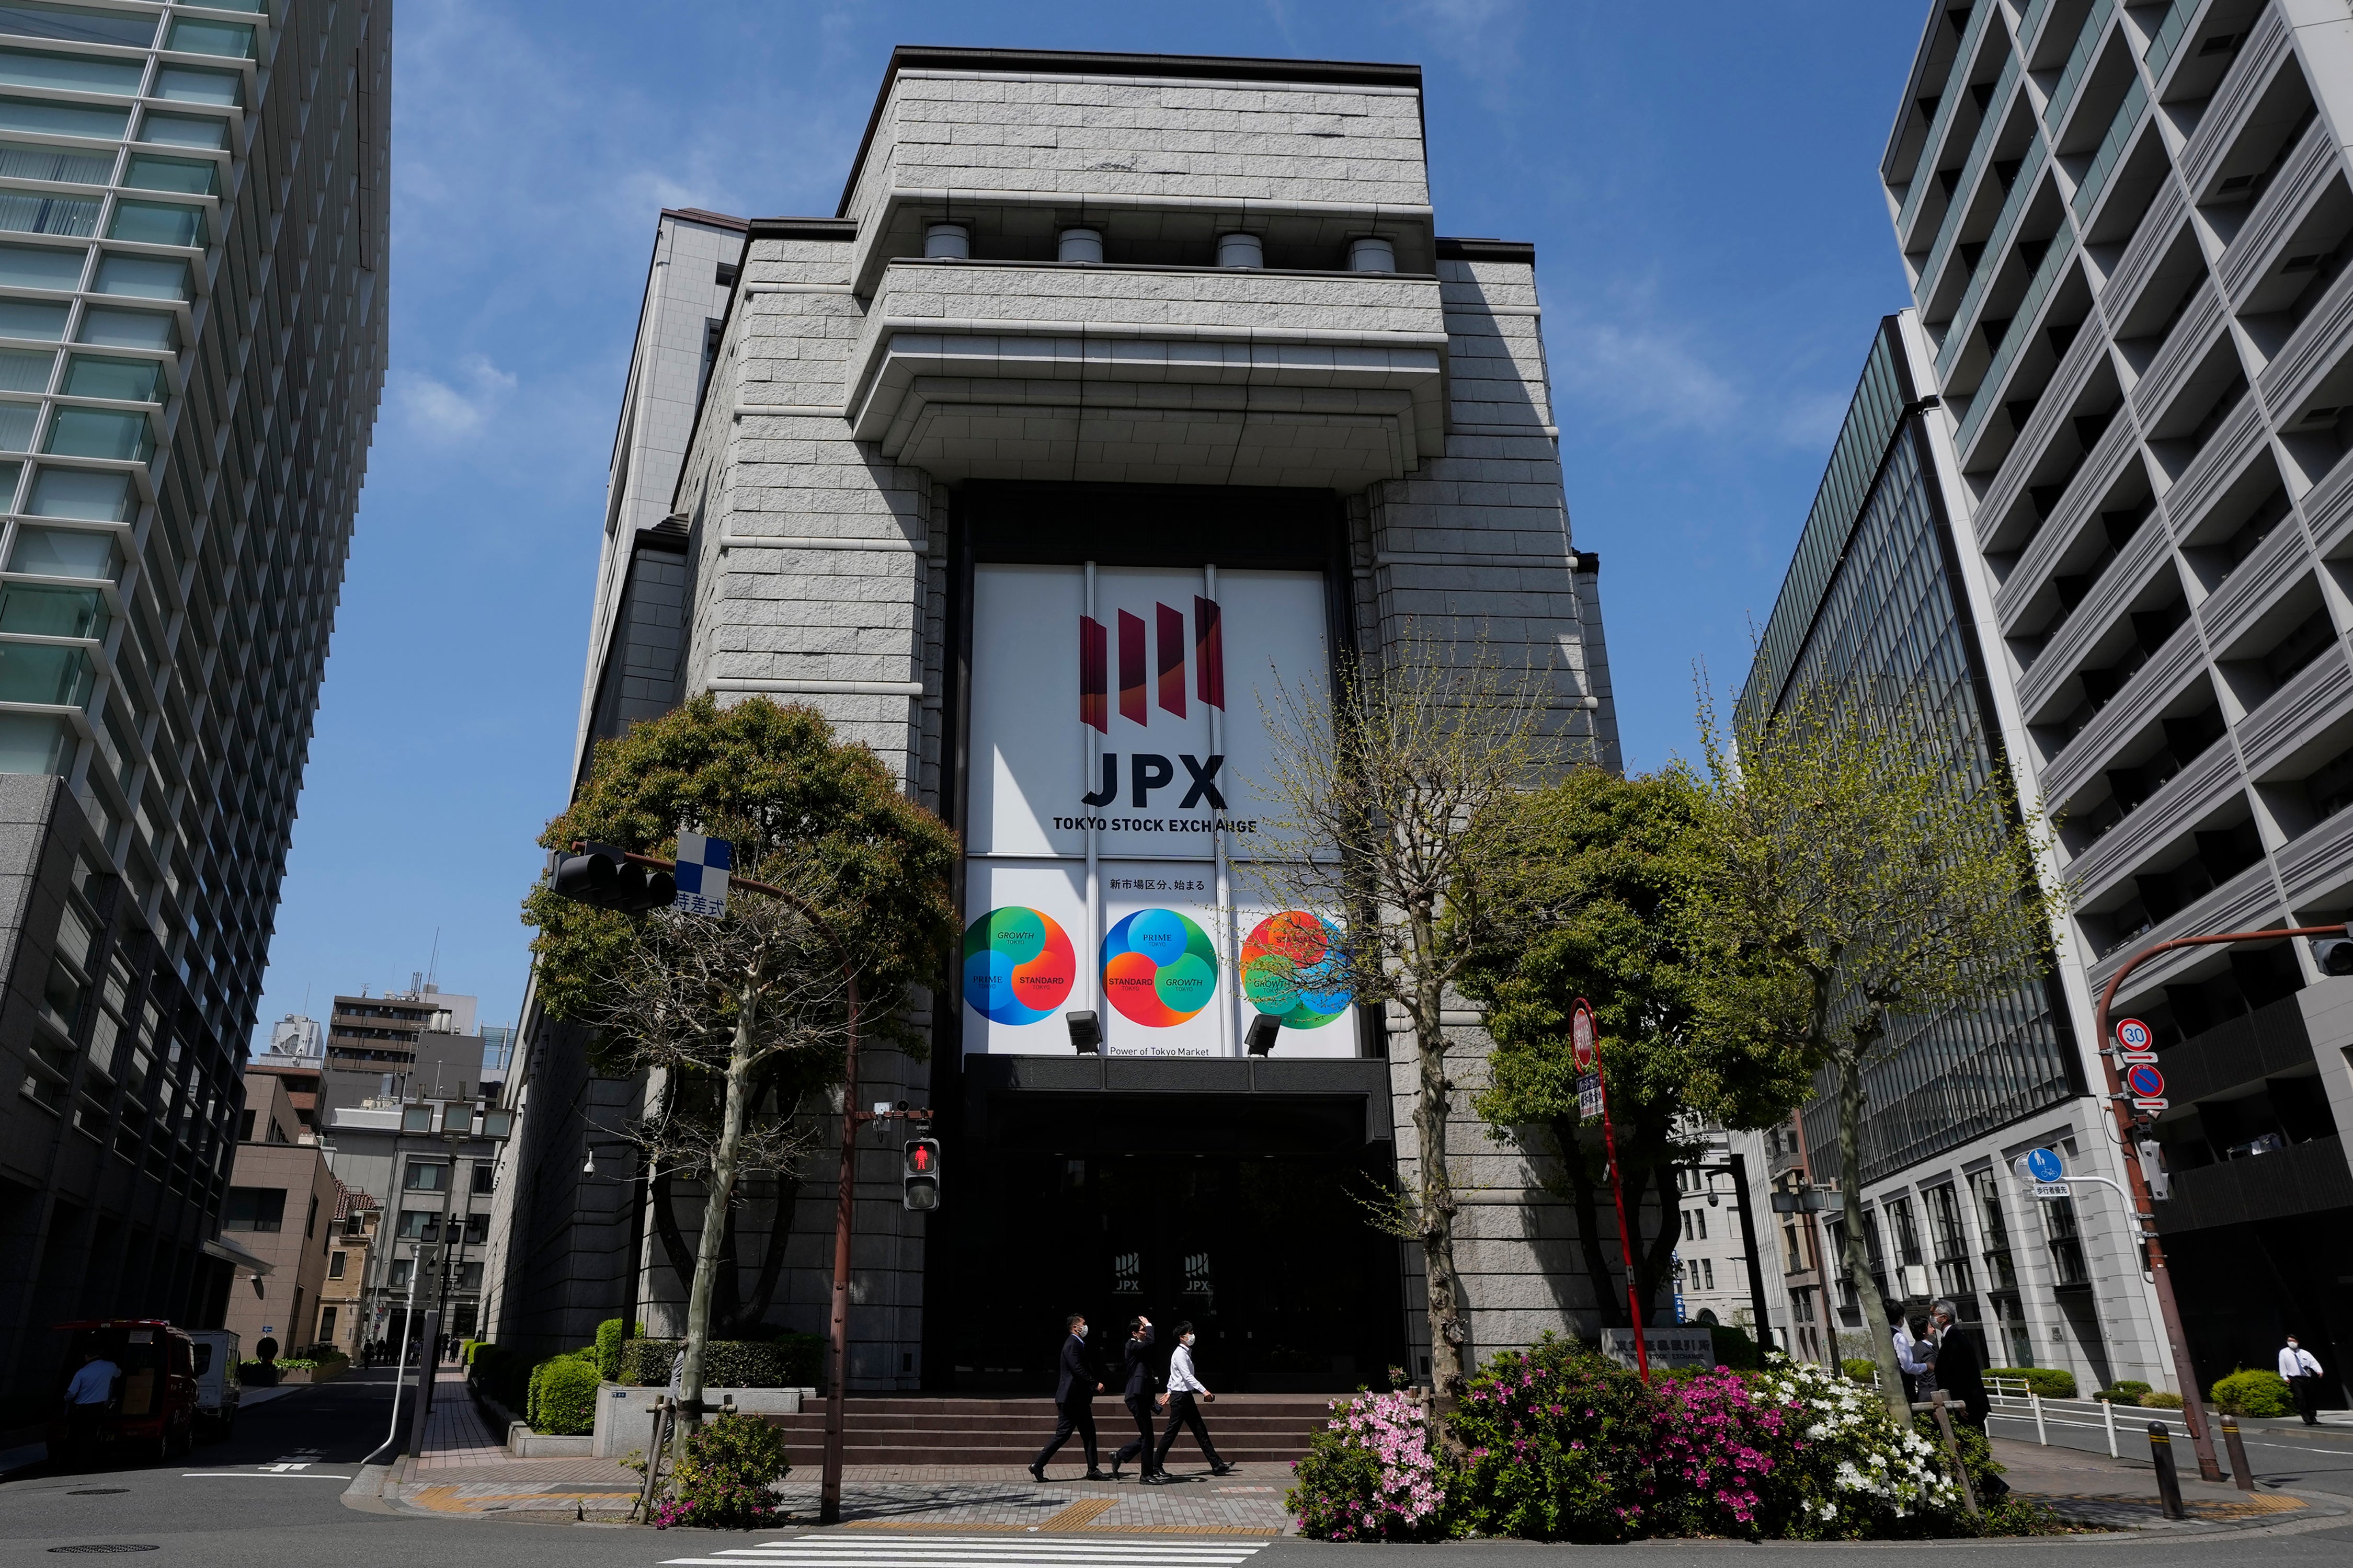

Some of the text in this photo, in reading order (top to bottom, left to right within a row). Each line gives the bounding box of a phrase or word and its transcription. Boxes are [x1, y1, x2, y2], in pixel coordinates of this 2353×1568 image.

[1081, 753, 1228, 809] JPX
[1053, 817, 1257, 833] TOKYO STOCK EXCHANGE
[1110, 879, 1205, 890] 新市場区分、始まる
[673, 893, 724, 918] 時差式
[2125, 1028, 2144, 1042] 30
[1110, 1047, 1137, 1055] Power
[1150, 1047, 1176, 1057] Tokyo
[1116, 1280, 1139, 1290] JPX
[1186, 1280, 1209, 1290] JPX
